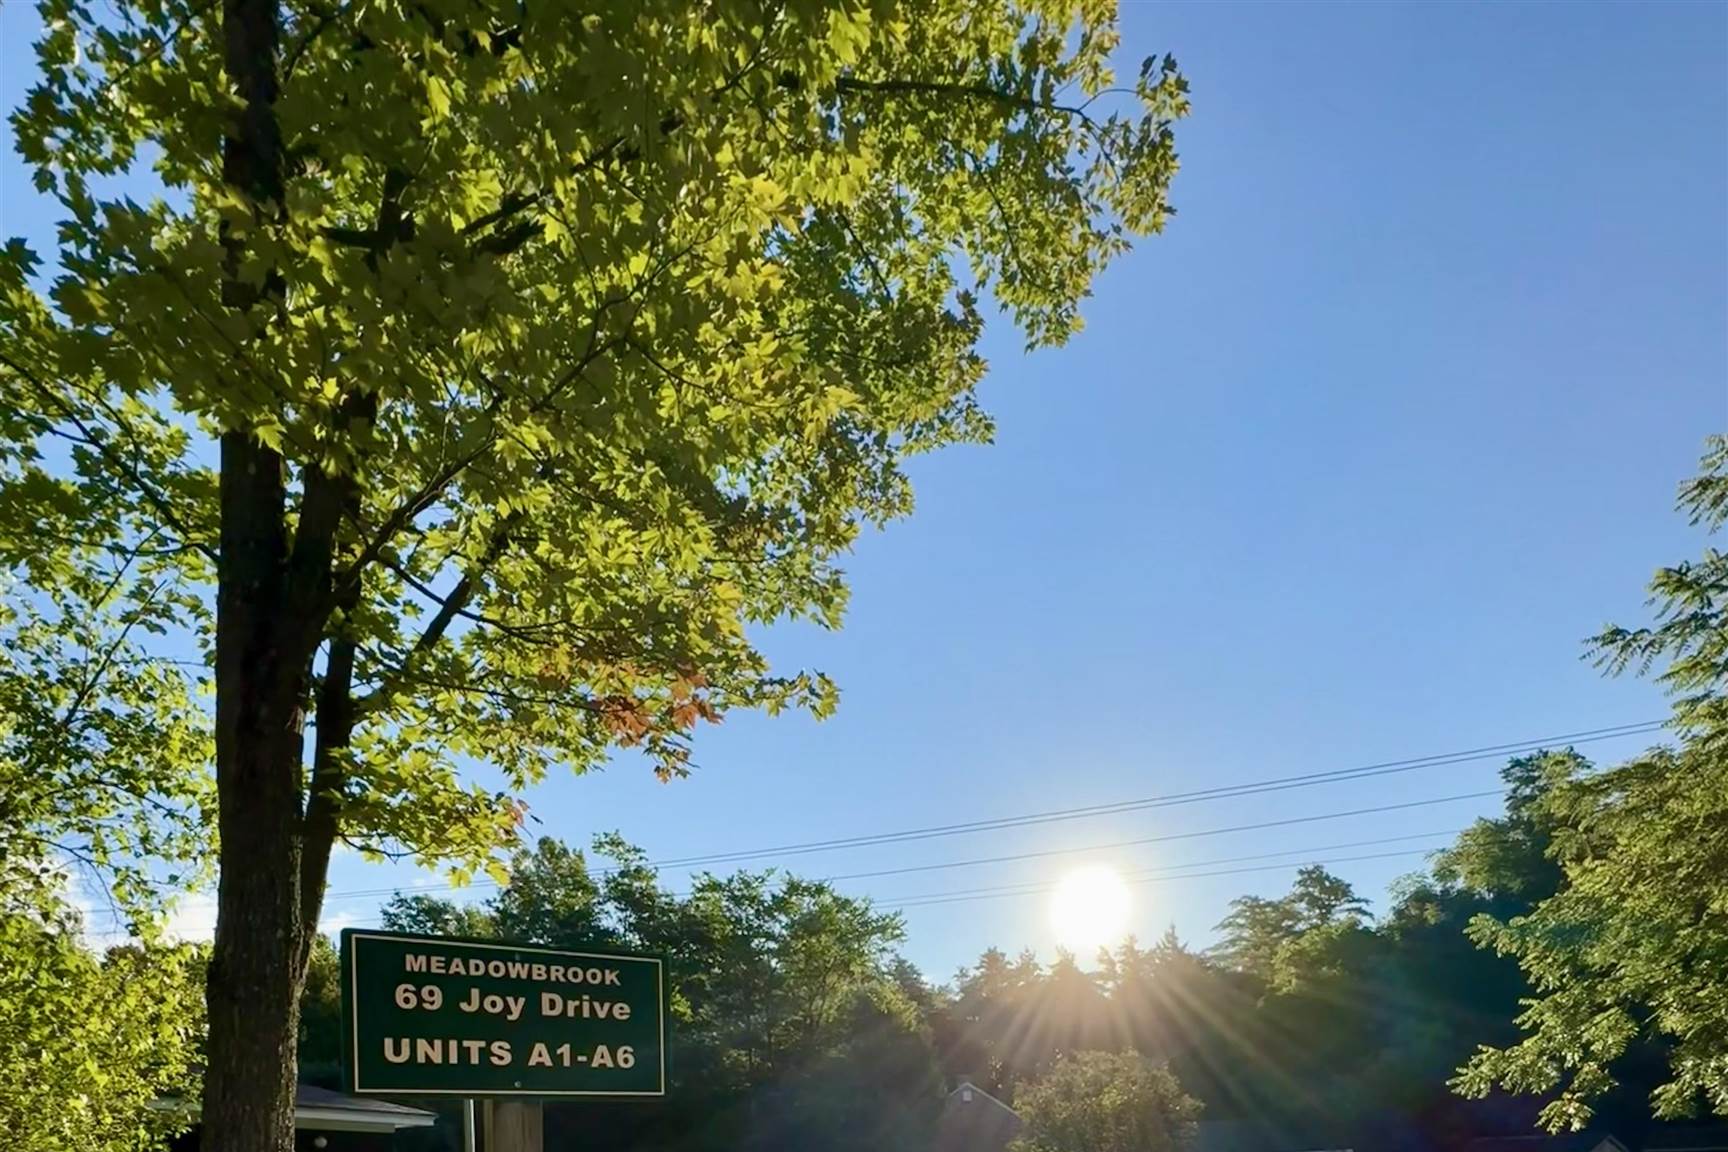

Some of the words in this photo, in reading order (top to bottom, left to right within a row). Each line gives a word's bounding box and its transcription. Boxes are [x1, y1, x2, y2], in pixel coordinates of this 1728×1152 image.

[405, 954, 621, 986] MEADOWBROOK
[394, 983, 443, 1011] 69
[459, 988, 526, 1021] Joy
[541, 992, 632, 1020] Drive
[383, 1037, 513, 1067] UNITS
[527, 1042, 636, 1069] A1-A6
